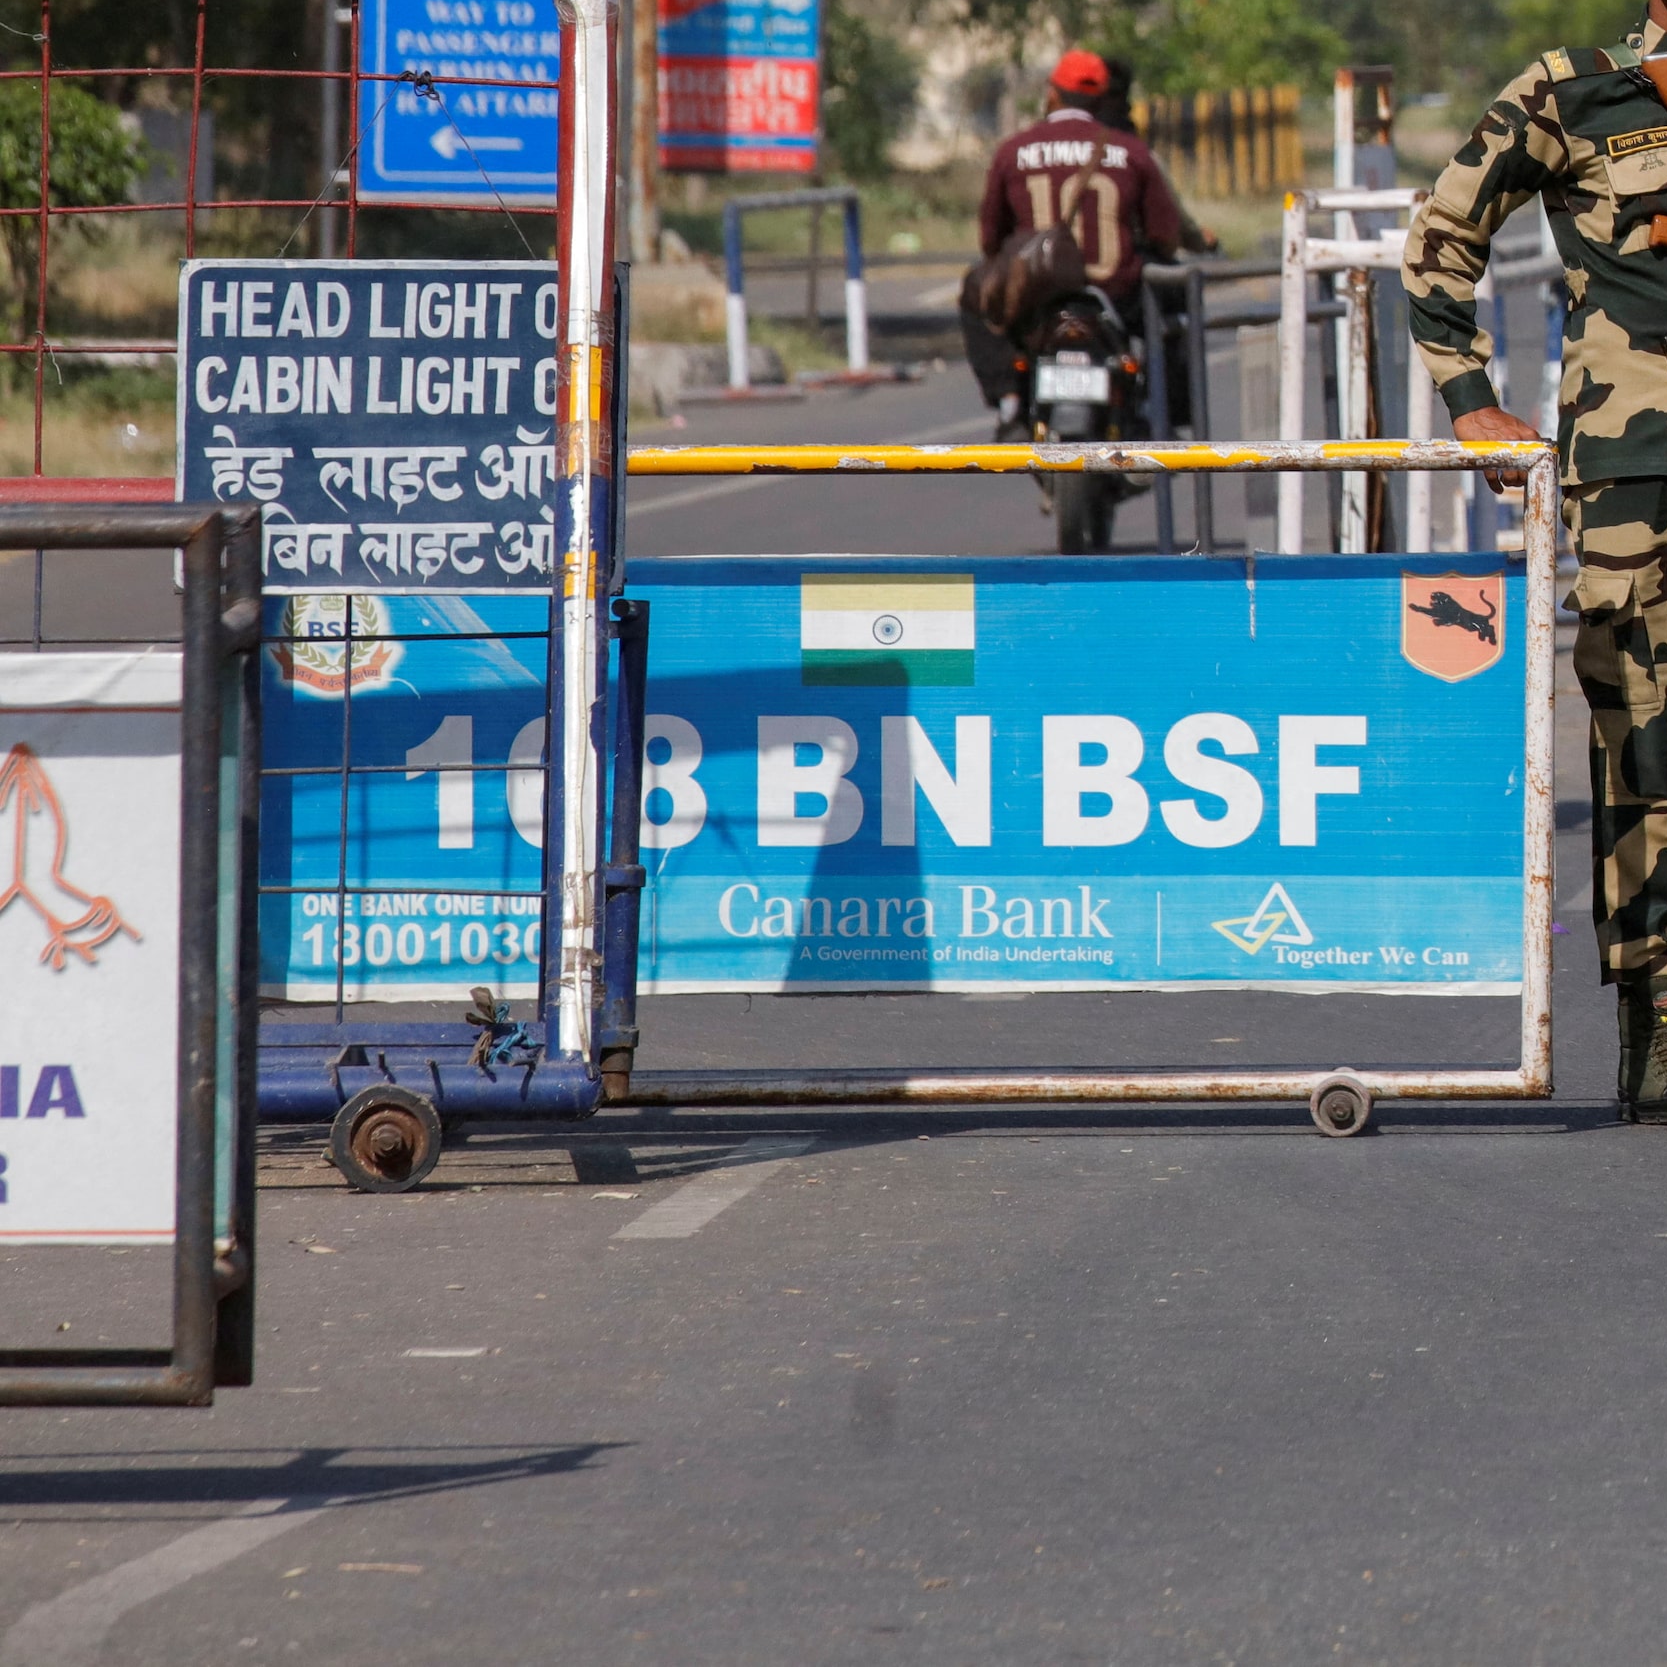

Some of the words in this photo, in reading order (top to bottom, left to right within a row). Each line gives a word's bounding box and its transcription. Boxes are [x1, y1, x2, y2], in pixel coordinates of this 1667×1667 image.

[1026, 172, 1122, 281] 10
[201, 281, 352, 339] HEAD
[369, 282, 522, 340] LIGHT
[195, 355, 352, 415] CABIN
[366, 356, 520, 416] LIGHT
[203, 424, 294, 502] हेड
[312, 446, 467, 515] लाइट
[359, 522, 494, 583] लाइट
[756, 715, 991, 848] BN
[1042, 712, 1367, 849] BSF
[302, 894, 352, 916] ONE
[361, 894, 428, 916] BANK
[435, 894, 485, 915] ONE
[493, 895, 541, 915] NUM
[718, 882, 936, 939] Canara
[958, 884, 1113, 940] Bank
[799, 946, 812, 961] A
[817, 945, 928, 962] Government
[933, 945, 951, 961] of
[956, 945, 999, 962] India
[1005, 945, 1114, 965] Undertaking
[1272, 945, 1373, 969] Together
[1378, 946, 1416, 966] We
[1422, 945, 1470, 966] Can
